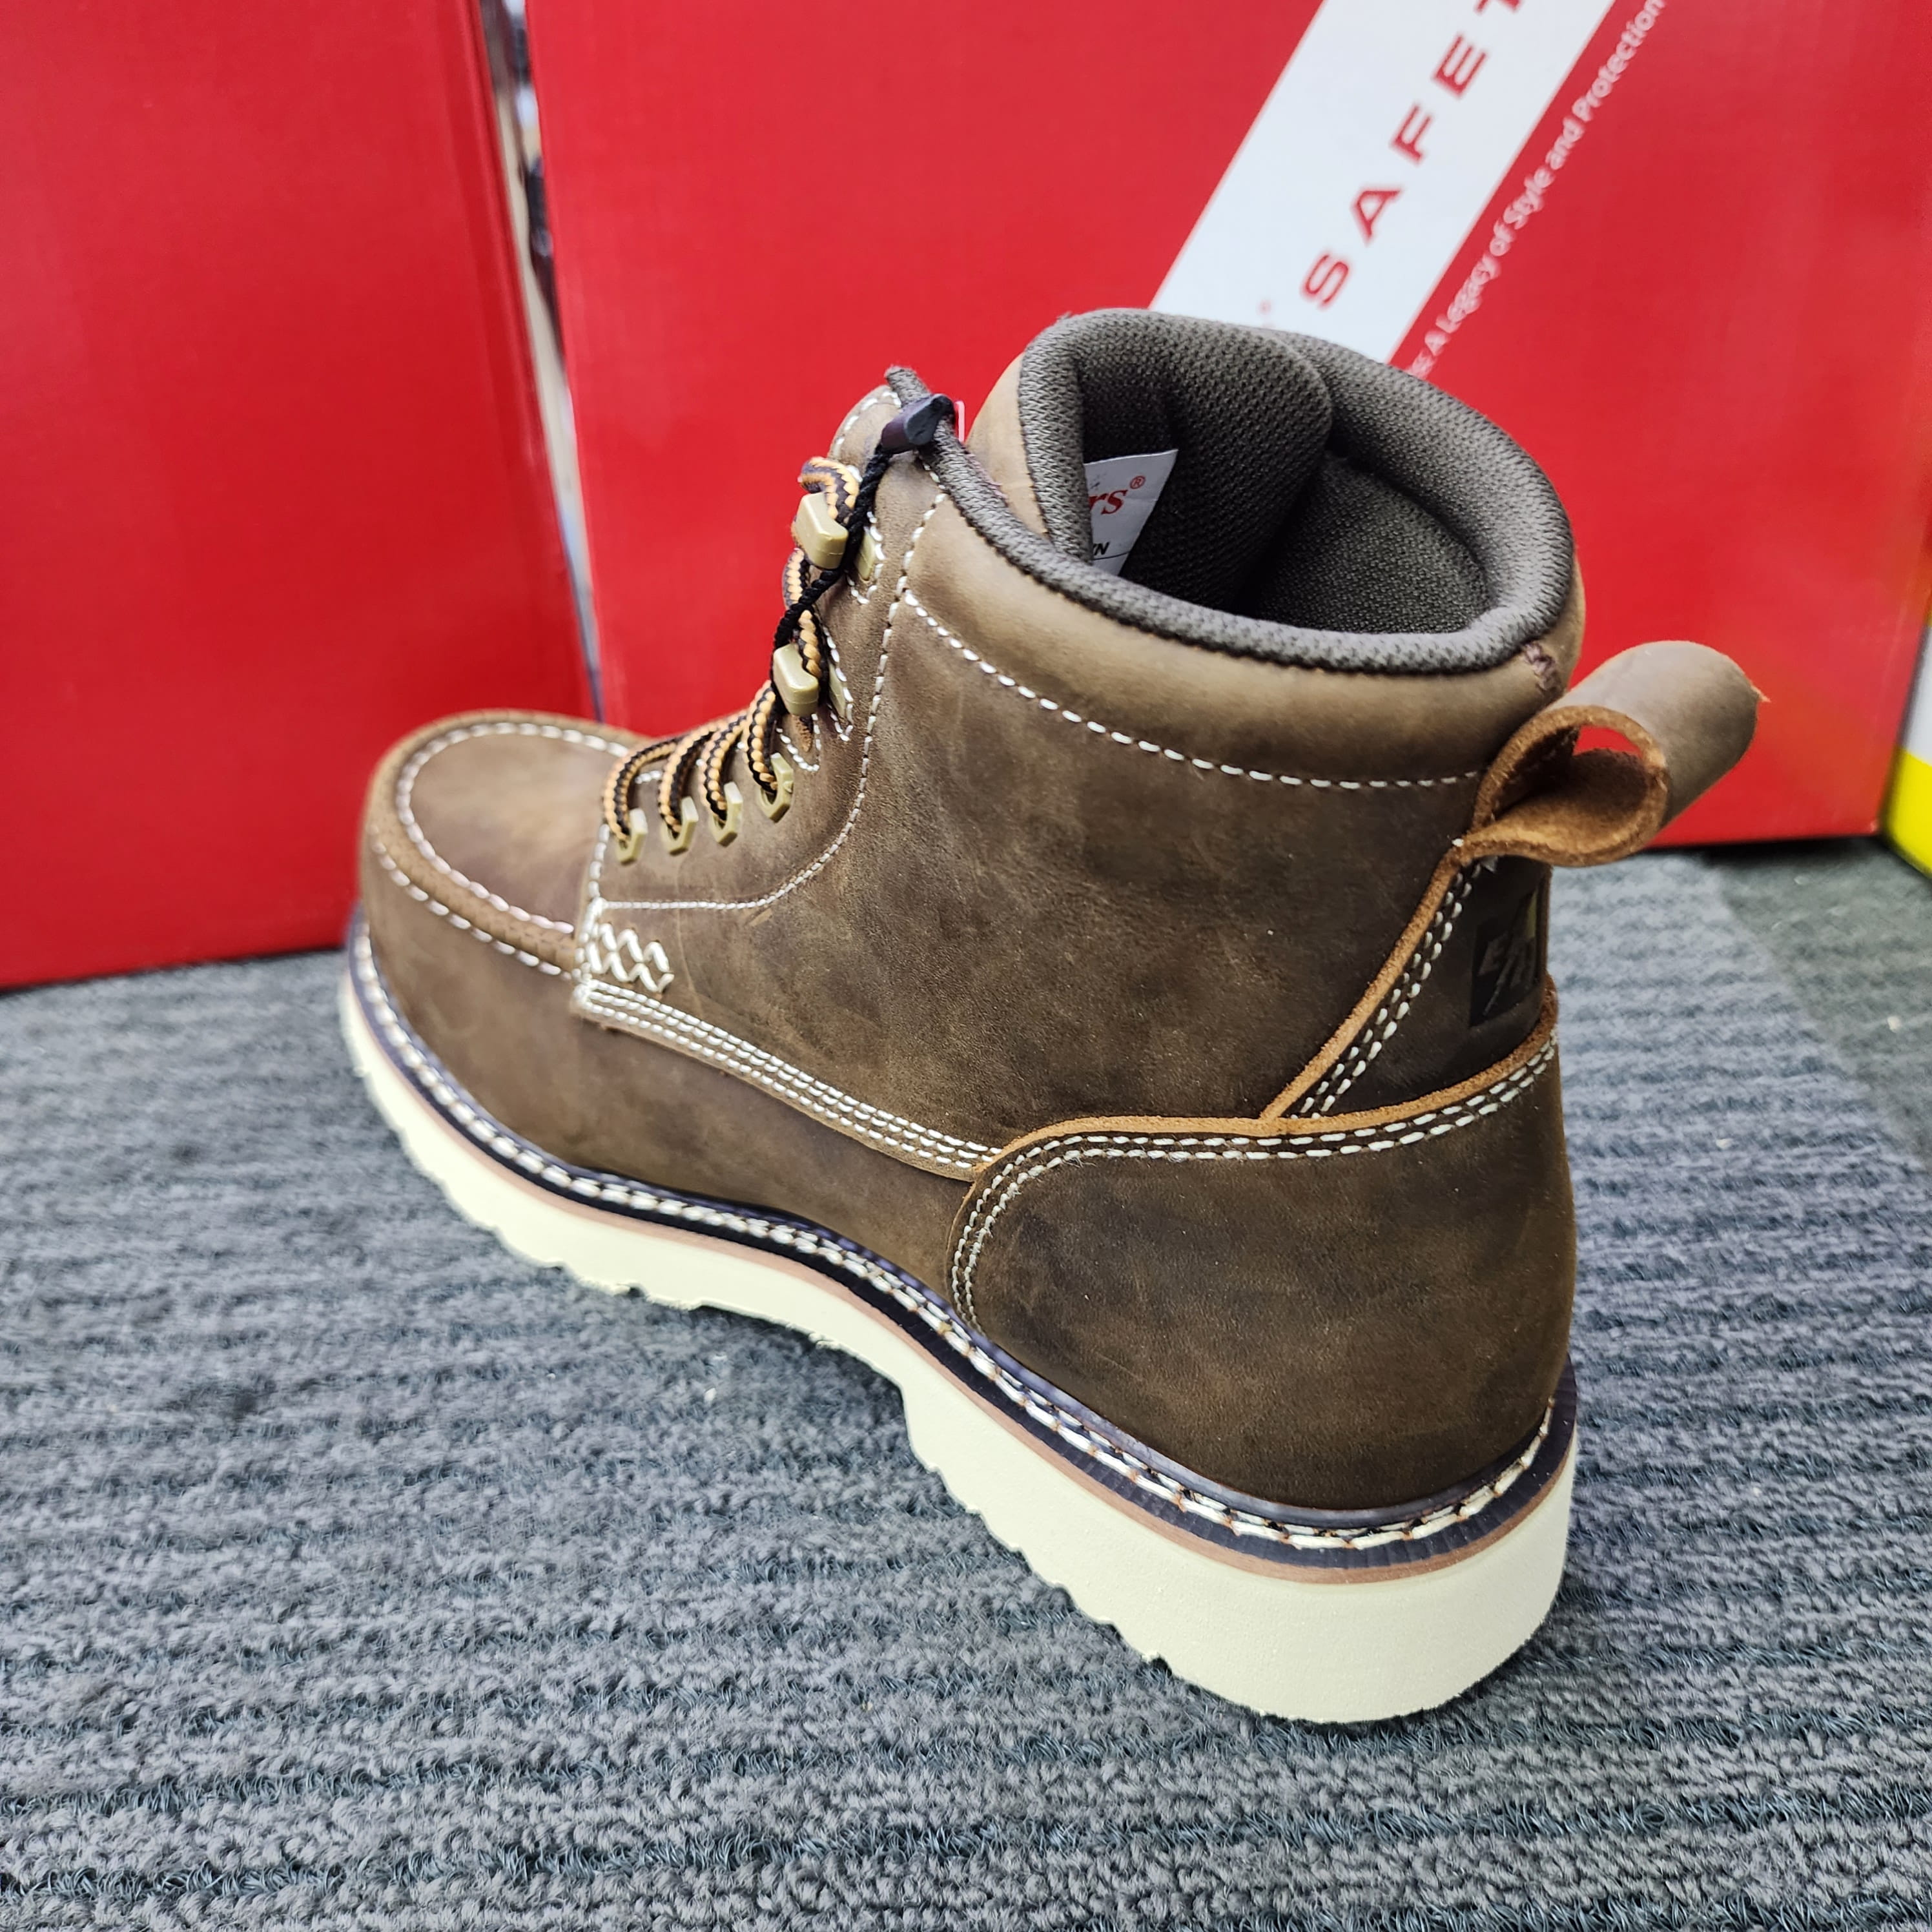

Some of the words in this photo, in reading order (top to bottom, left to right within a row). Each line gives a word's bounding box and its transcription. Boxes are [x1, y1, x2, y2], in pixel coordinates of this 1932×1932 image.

[1435, 252, 1500, 334] Legacy
[1489, 218, 1516, 256] of
[1503, 166, 1555, 230] Style
[1545, 116, 1584, 170] and
[1572, 0, 1665, 122] Protection
